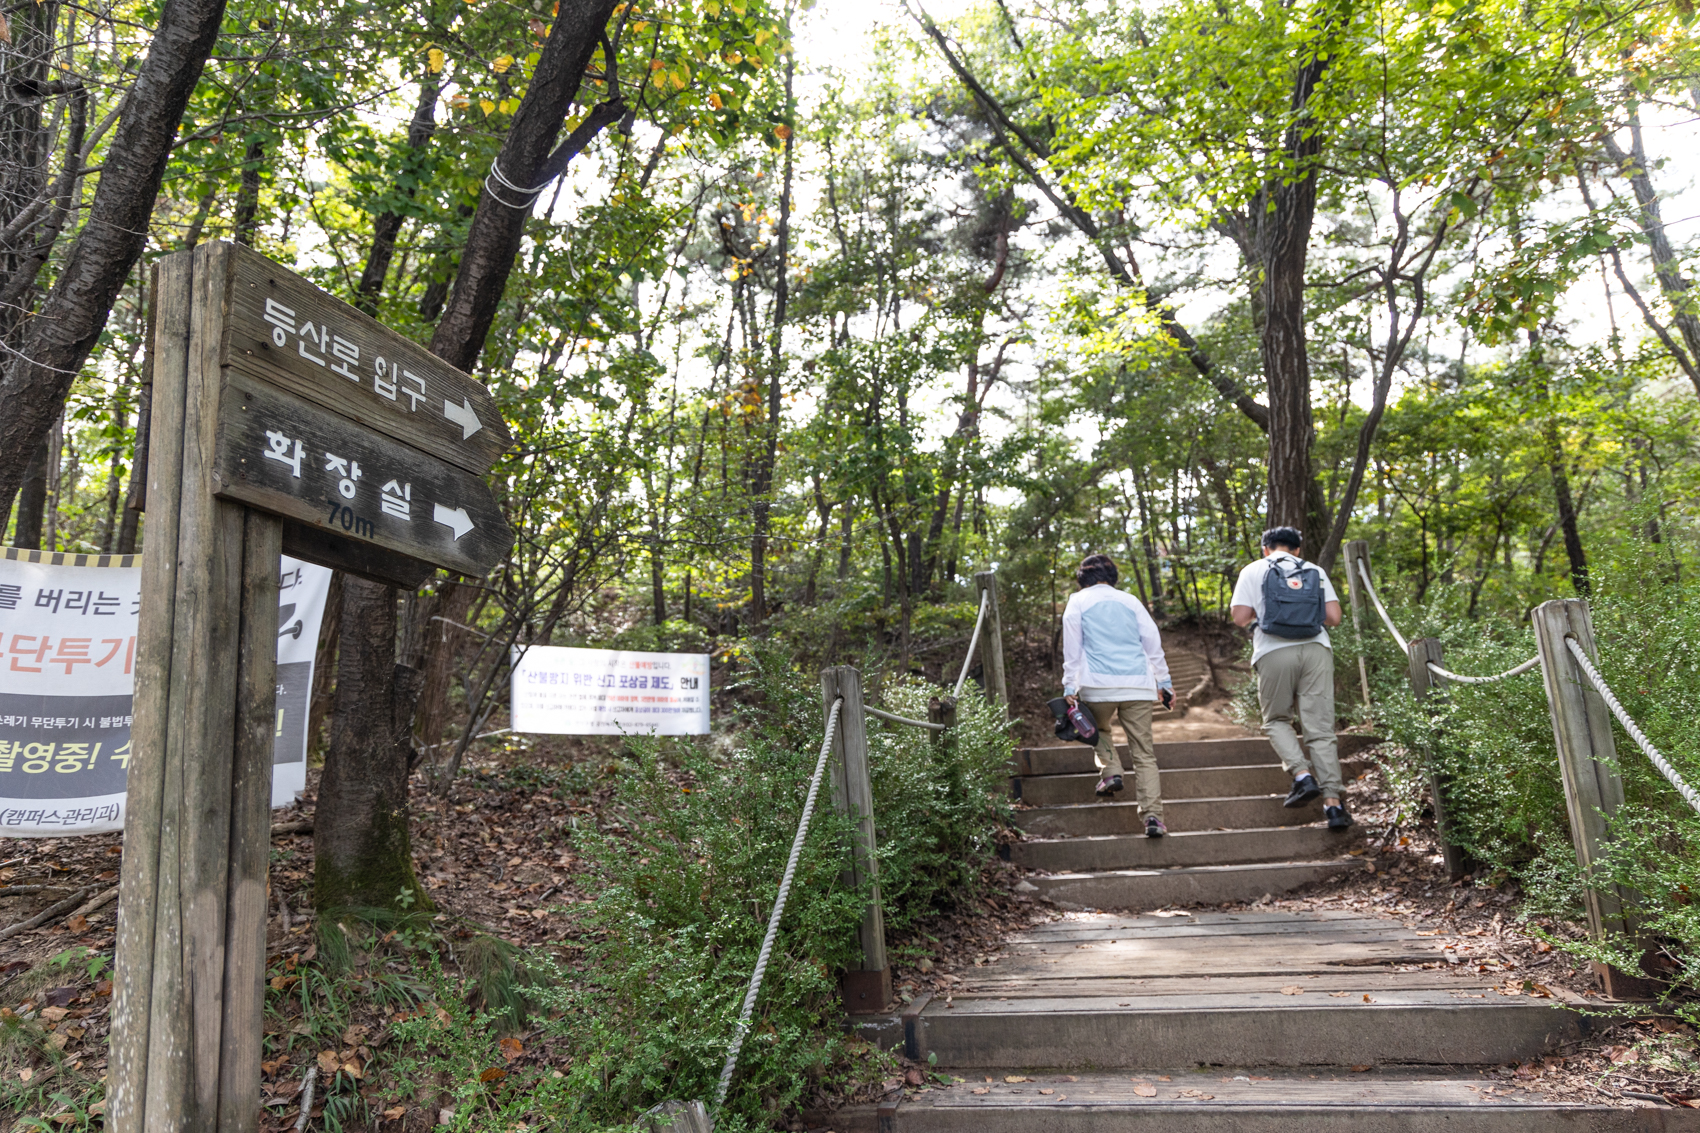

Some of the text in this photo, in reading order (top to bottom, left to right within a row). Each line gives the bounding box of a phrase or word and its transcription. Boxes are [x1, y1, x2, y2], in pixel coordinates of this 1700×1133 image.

[264, 298, 426, 412] 등산로 입구
[327, 500, 375, 539] 70m
[34, 589, 121, 615] 버리는
[0, 632, 137, 675] 단투기
[619, 675, 648, 689] 포상금
[680, 677, 699, 690] 안내
[31, 717, 79, 729] 무단투기
[83, 717, 95, 728] 시
[0, 803, 120, 826] (캠퍼스관리과)
